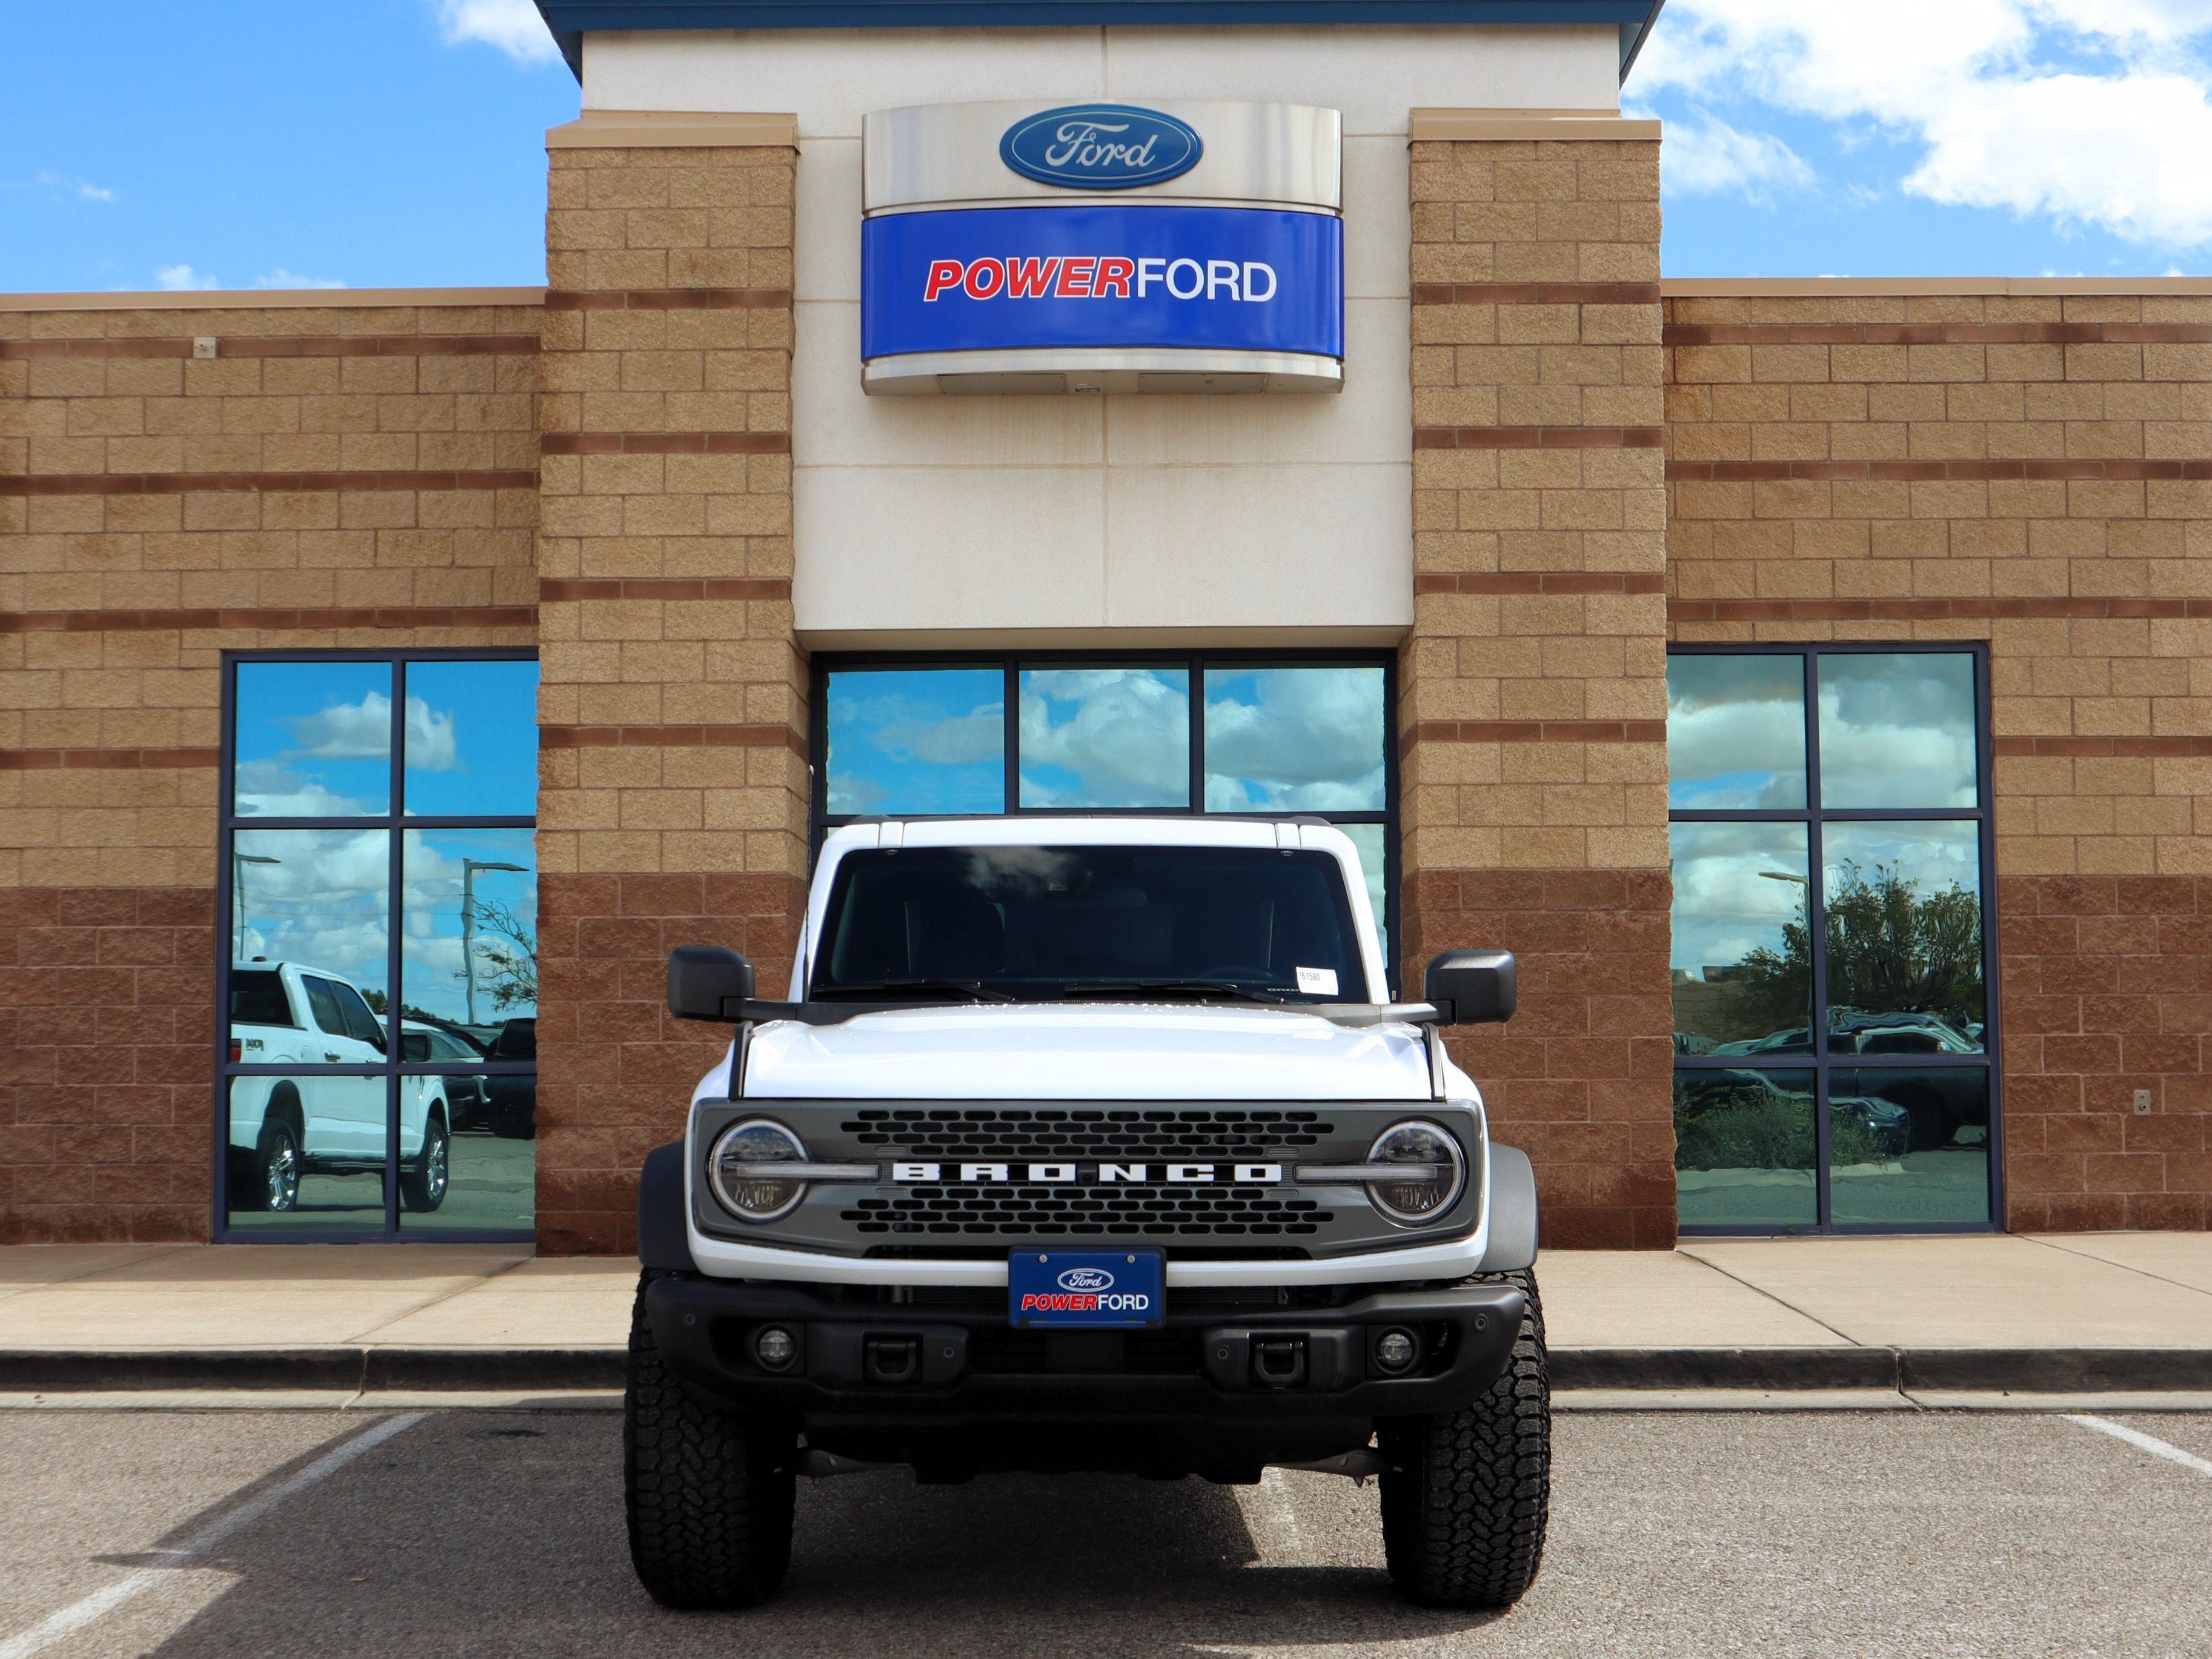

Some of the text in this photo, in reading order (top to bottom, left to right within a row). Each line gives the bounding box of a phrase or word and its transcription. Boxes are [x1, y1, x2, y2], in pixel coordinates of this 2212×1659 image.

[1045, 121, 1158, 168] Ford
[923, 256, 1277, 302] POWERFORD
[892, 1163, 1282, 1182] BRONCO
[1069, 1272, 1103, 1288] Ford
[1021, 1293, 1149, 1311] POWERFORD
